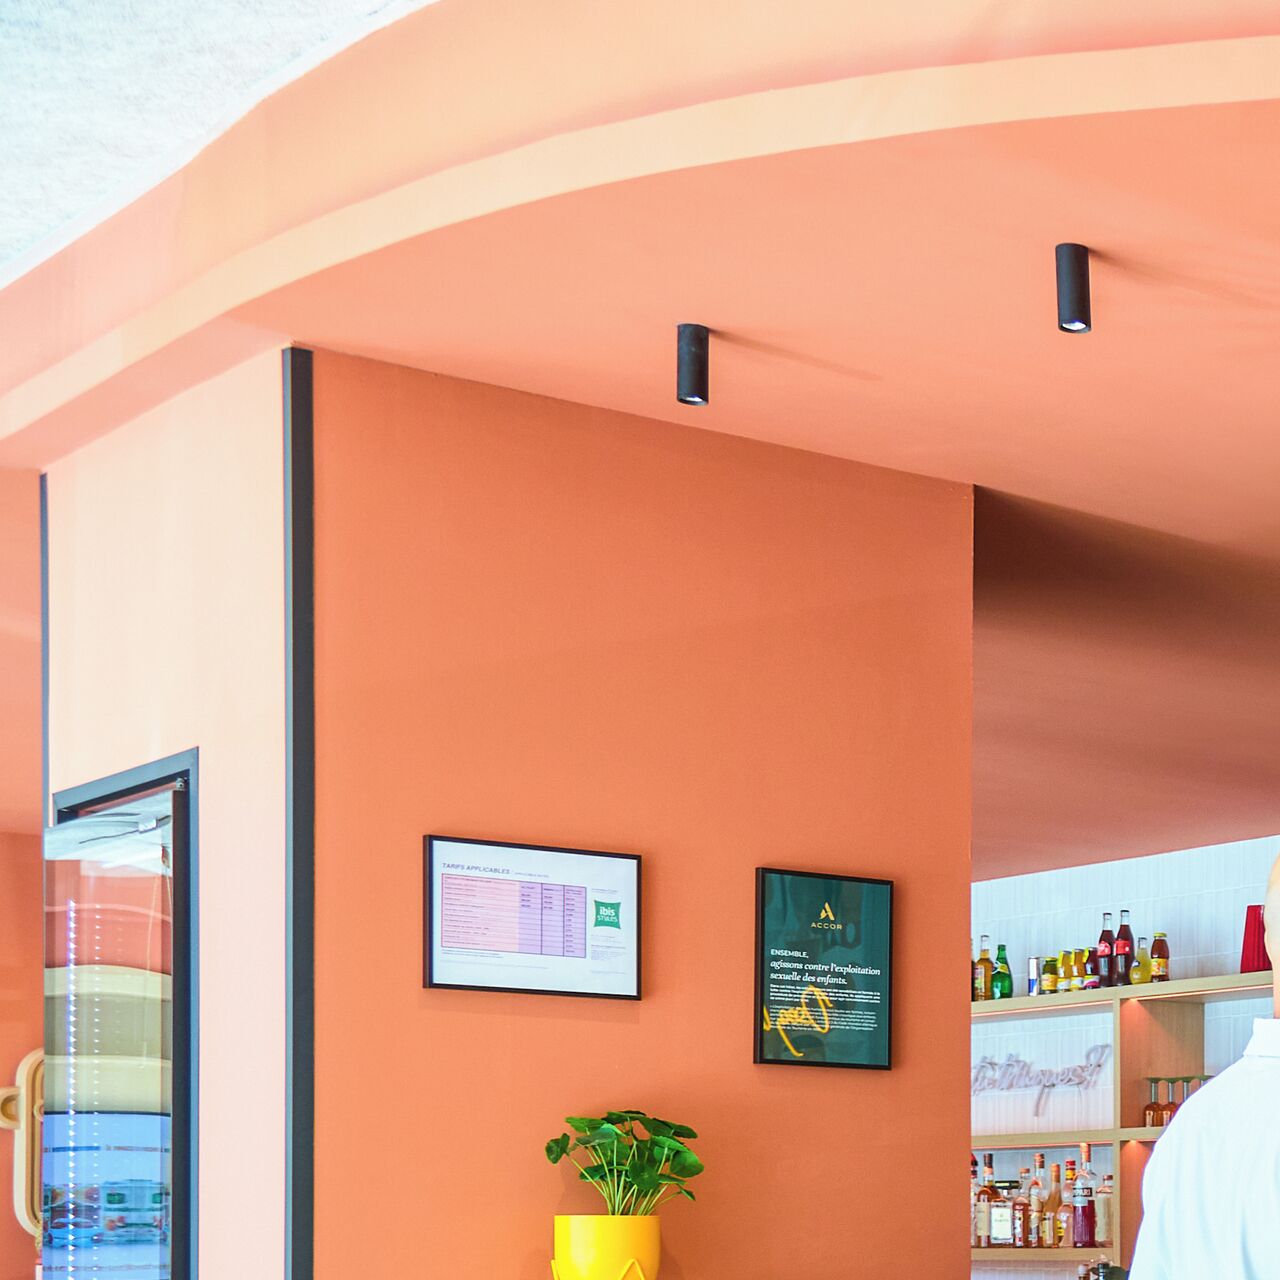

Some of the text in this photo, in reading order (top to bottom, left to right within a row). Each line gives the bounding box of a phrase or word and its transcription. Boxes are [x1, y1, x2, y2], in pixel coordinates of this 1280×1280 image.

[466, 865, 510, 874] APPLICABLES
[599, 907, 616, 917] ibis
[810, 922, 843, 930] ACCOR
[770, 948, 809, 959] ENSEMBLE,
[770, 960, 880, 976] agissons contre l'exploitation
[770, 971, 847, 985] sexuelle des enfants.
